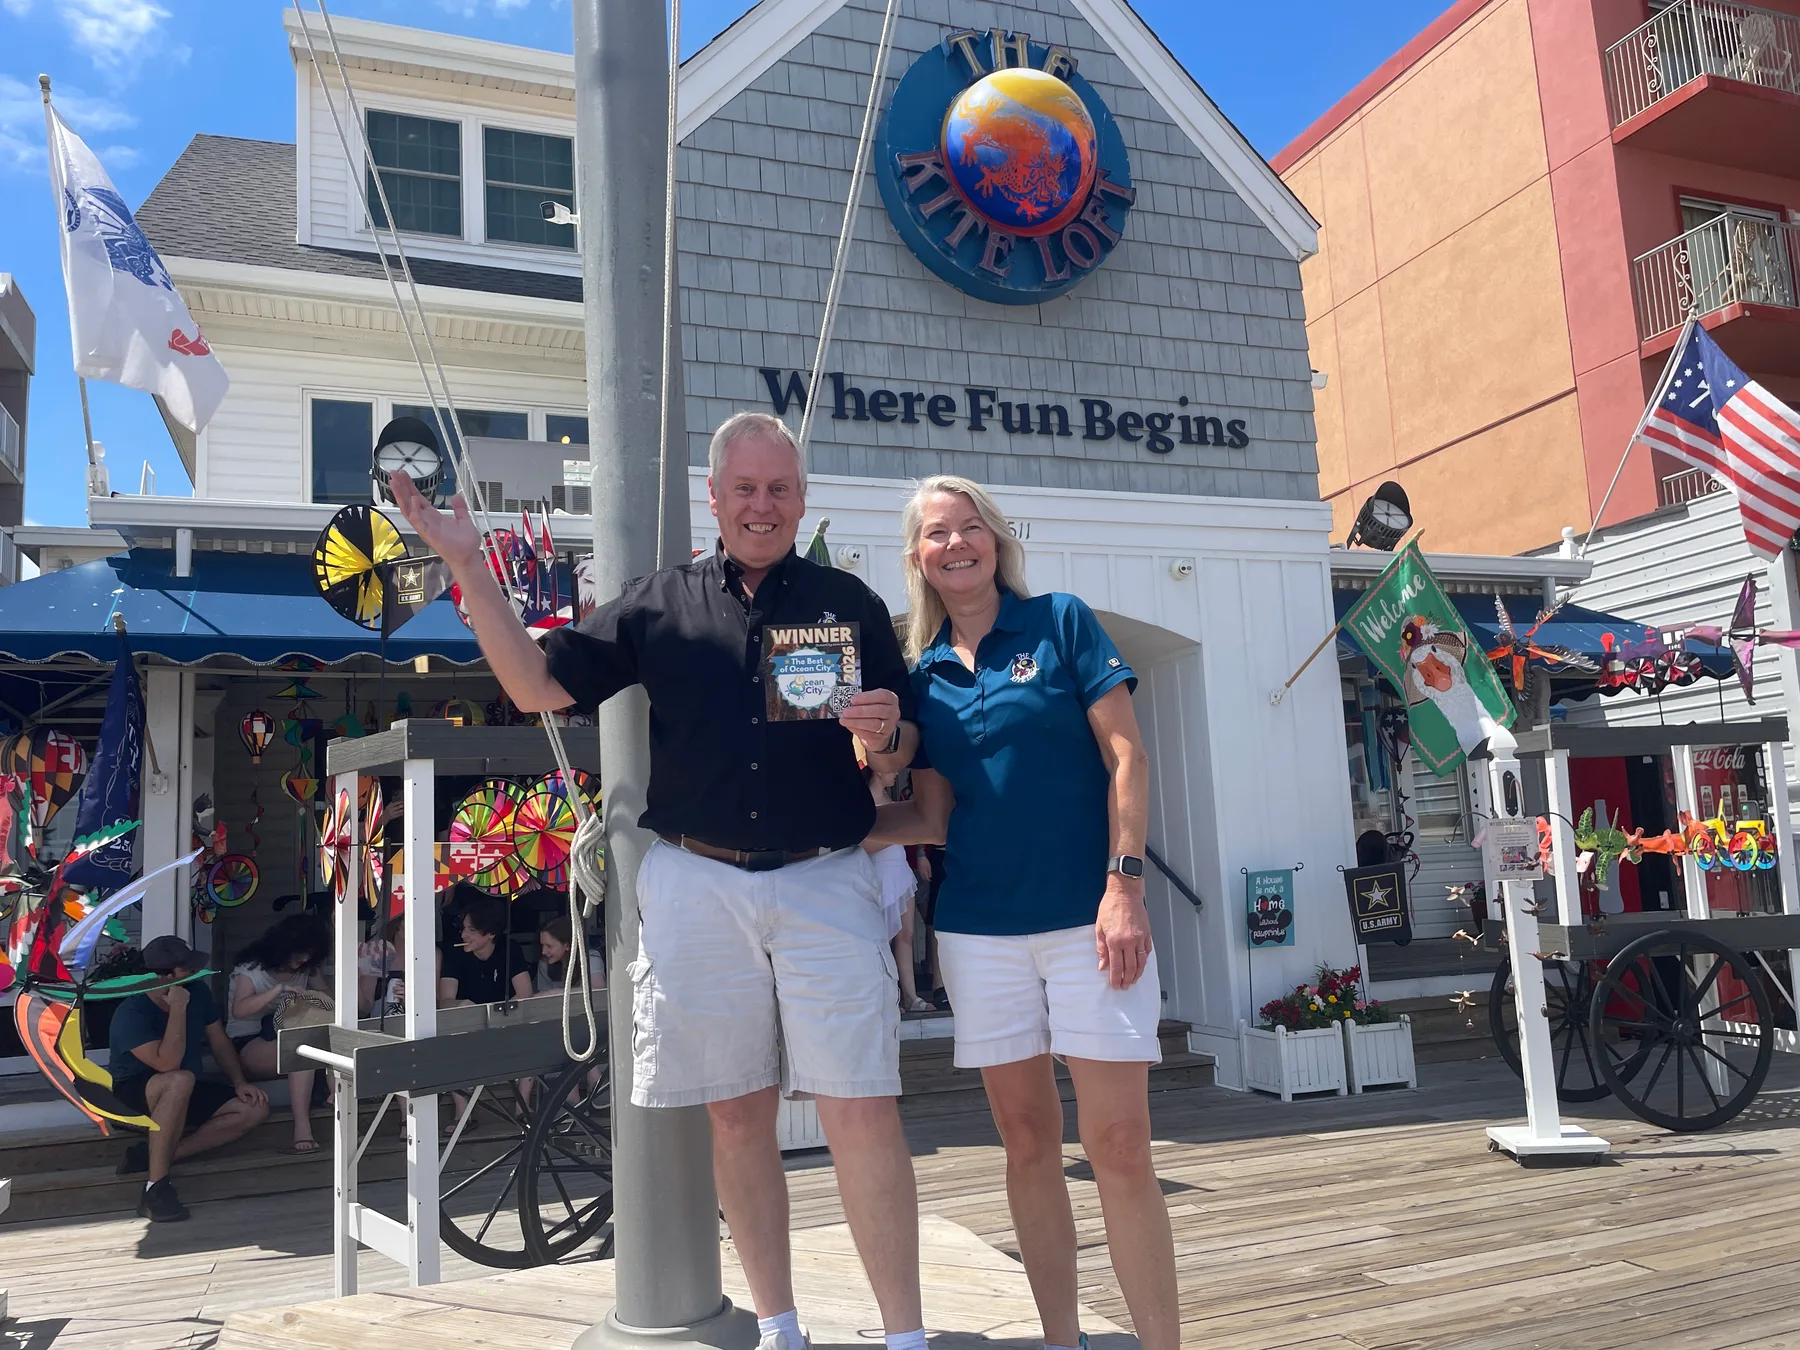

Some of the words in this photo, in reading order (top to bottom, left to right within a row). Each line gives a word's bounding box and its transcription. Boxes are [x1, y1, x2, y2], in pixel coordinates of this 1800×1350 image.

[942, 27, 1079, 82] THE
[896, 148, 1017, 280] KITE
[1033, 168, 1137, 283] LOFT
[759, 368, 957, 427] Where
[965, 388, 1073, 437] Fun
[1080, 396, 1250, 454] Begins
[1360, 574, 1426, 643] Welcome
[771, 626, 854, 645] WINNER
[779, 665, 788, 673] of
[789, 665, 815, 673] Ocean
[806, 657, 823, 665] Best
[842, 646, 856, 683] 2026
[1255, 876, 1261, 885] A
[1255, 886, 1263, 895] is
[1264, 884, 1278, 894] not
[1279, 885, 1284, 893] a
